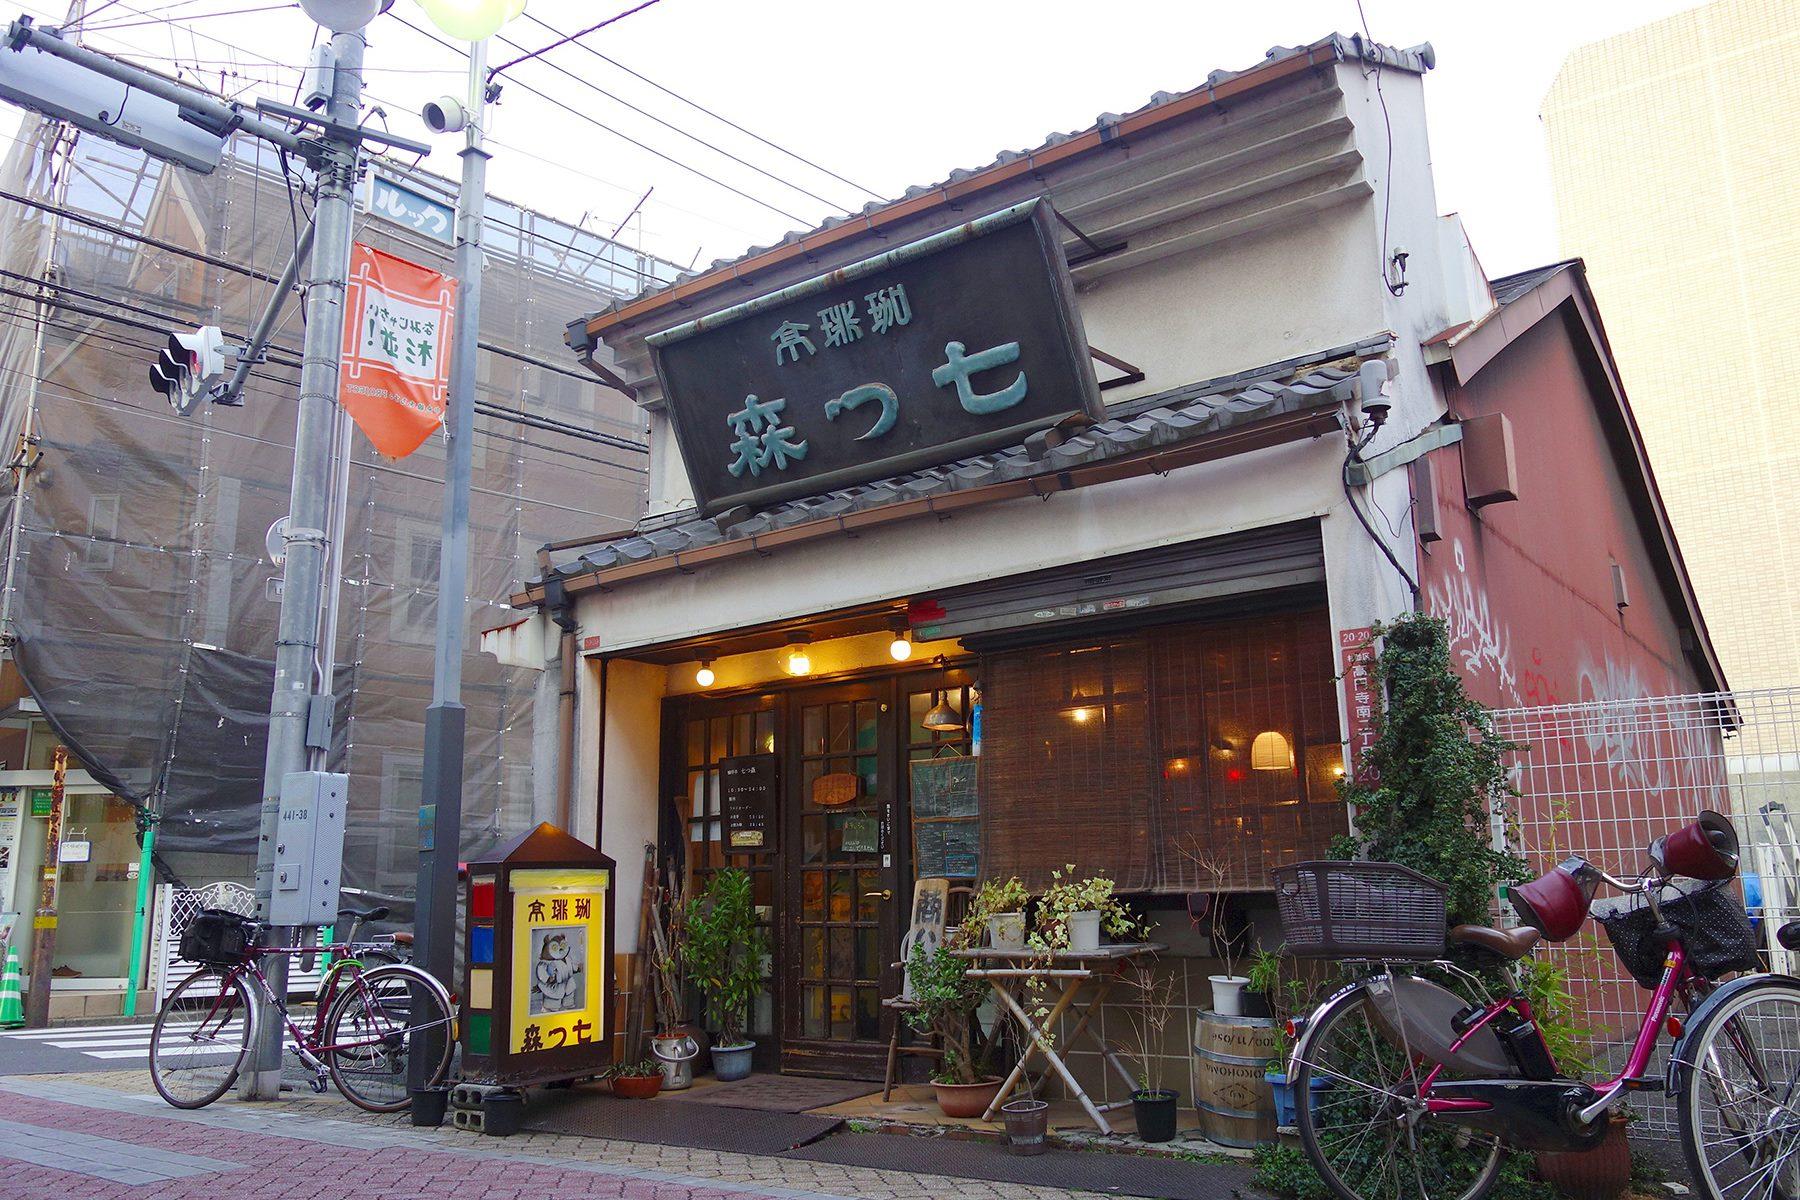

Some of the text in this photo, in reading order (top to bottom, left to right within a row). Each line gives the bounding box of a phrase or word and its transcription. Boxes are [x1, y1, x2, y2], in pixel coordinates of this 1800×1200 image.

[376, 188, 447, 234] ルック
[726, 340, 1029, 478] 七つ森
[1342, 631, 1370, 643] 20-20
[283, 809, 308, 821] 441-38
[520, 1018, 592, 1053] 七つ森
